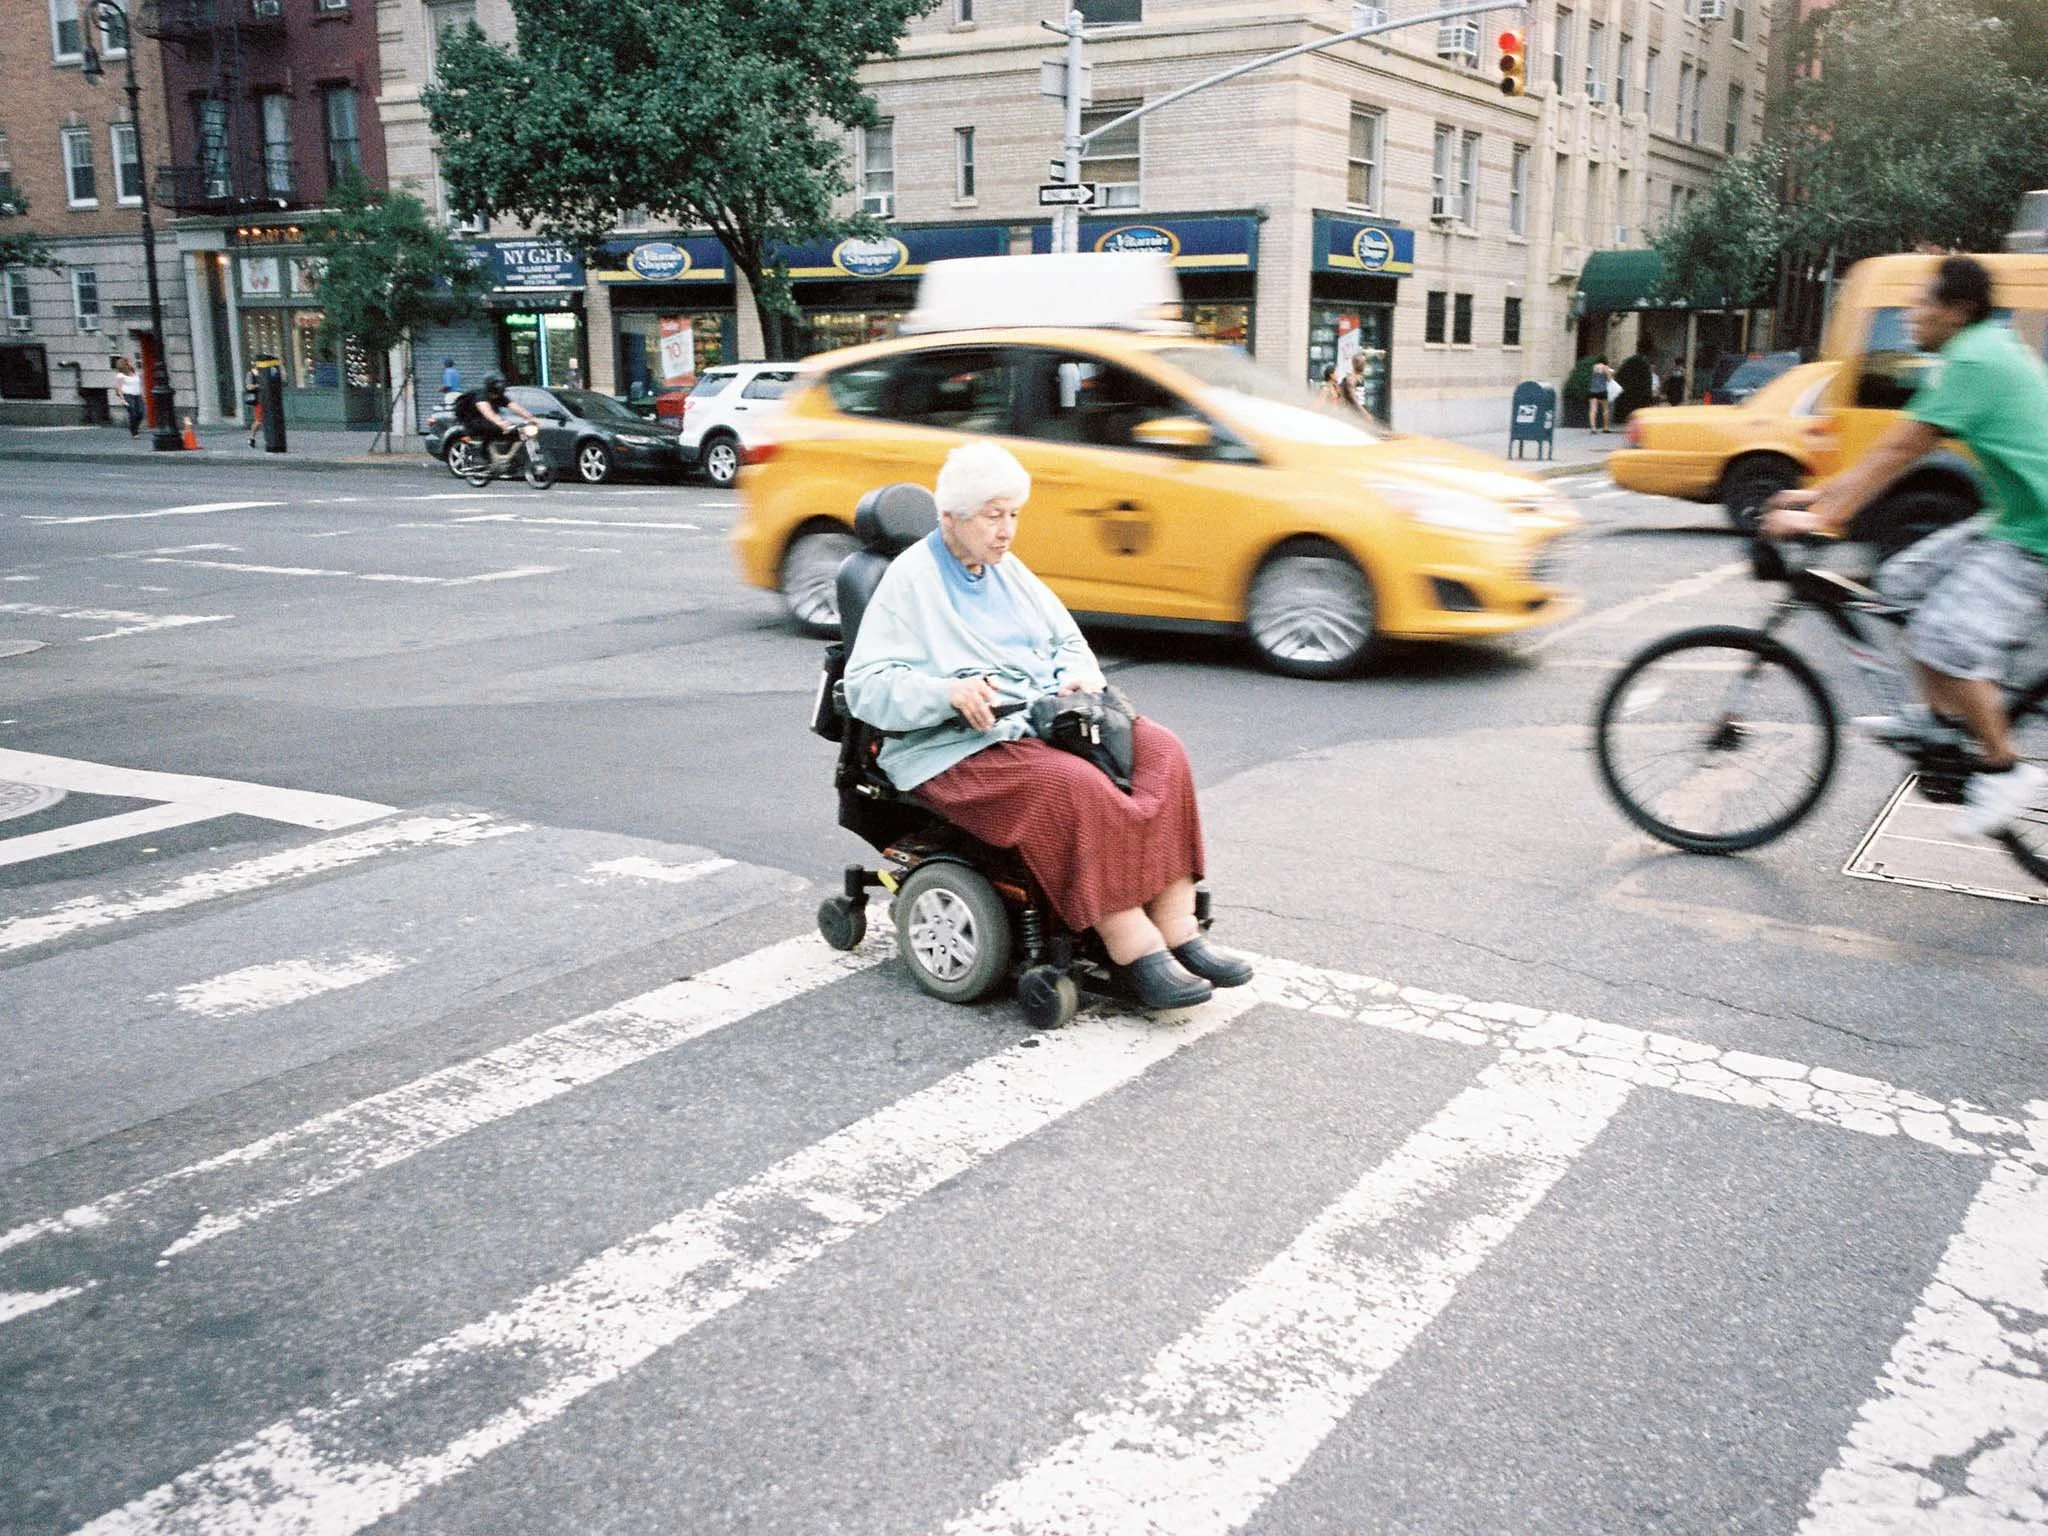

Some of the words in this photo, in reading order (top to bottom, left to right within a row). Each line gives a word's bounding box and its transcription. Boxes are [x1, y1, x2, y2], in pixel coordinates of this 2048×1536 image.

[503, 250, 525, 265] NY
[527, 247, 573, 264] GIFTS
[637, 260, 677, 271] Shoppe
